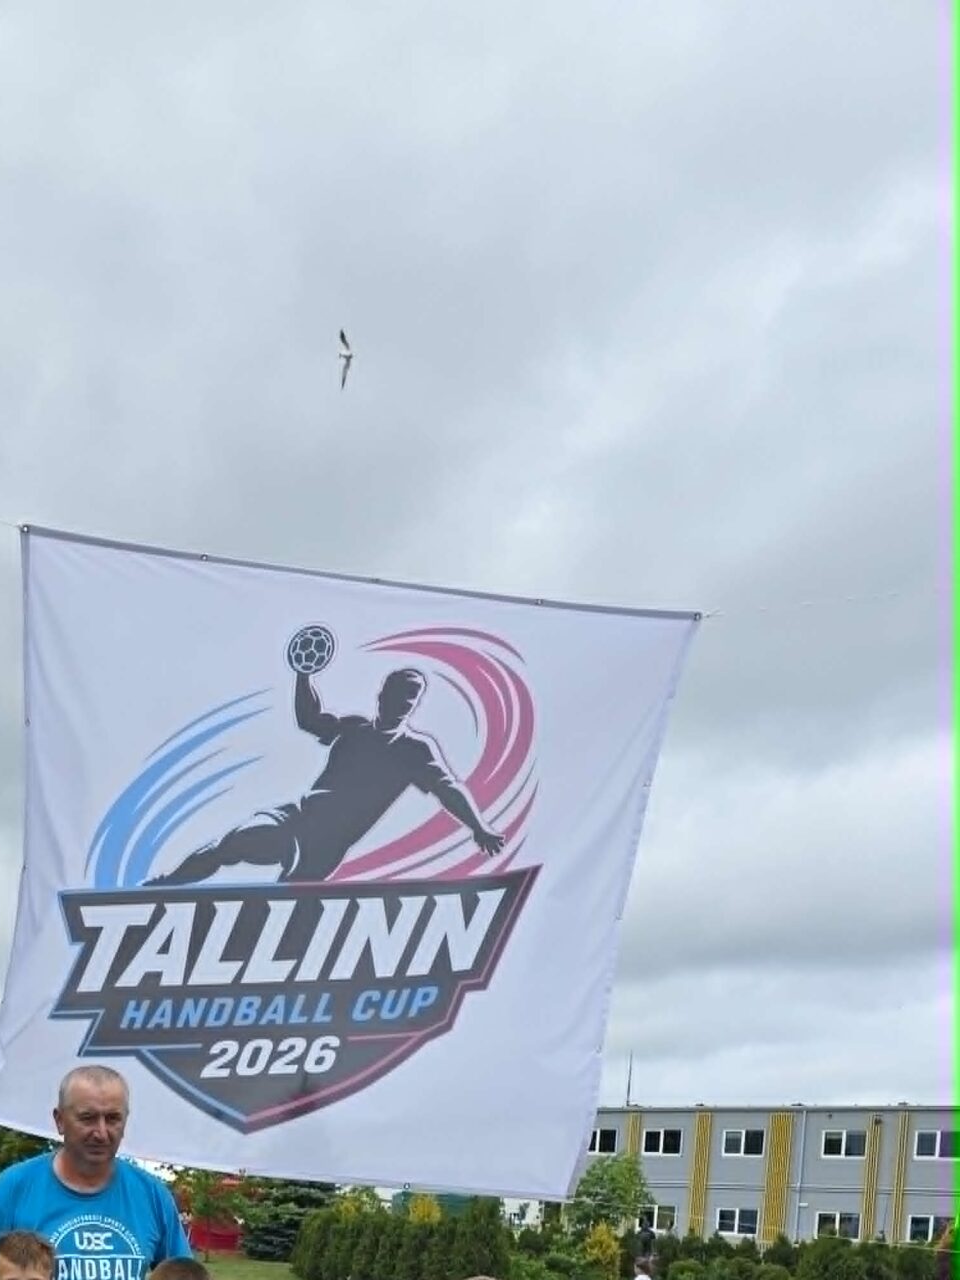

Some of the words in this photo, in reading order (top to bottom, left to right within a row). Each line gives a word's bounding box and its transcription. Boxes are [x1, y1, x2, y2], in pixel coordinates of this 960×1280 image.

[76, 887, 507, 993] TALLINN
[120, 992, 333, 1029] HANDBALL
[351, 985, 440, 1022] CUP
[200, 1035, 341, 1080] 2026
[58, 1259, 142, 1280] ANDBALL
